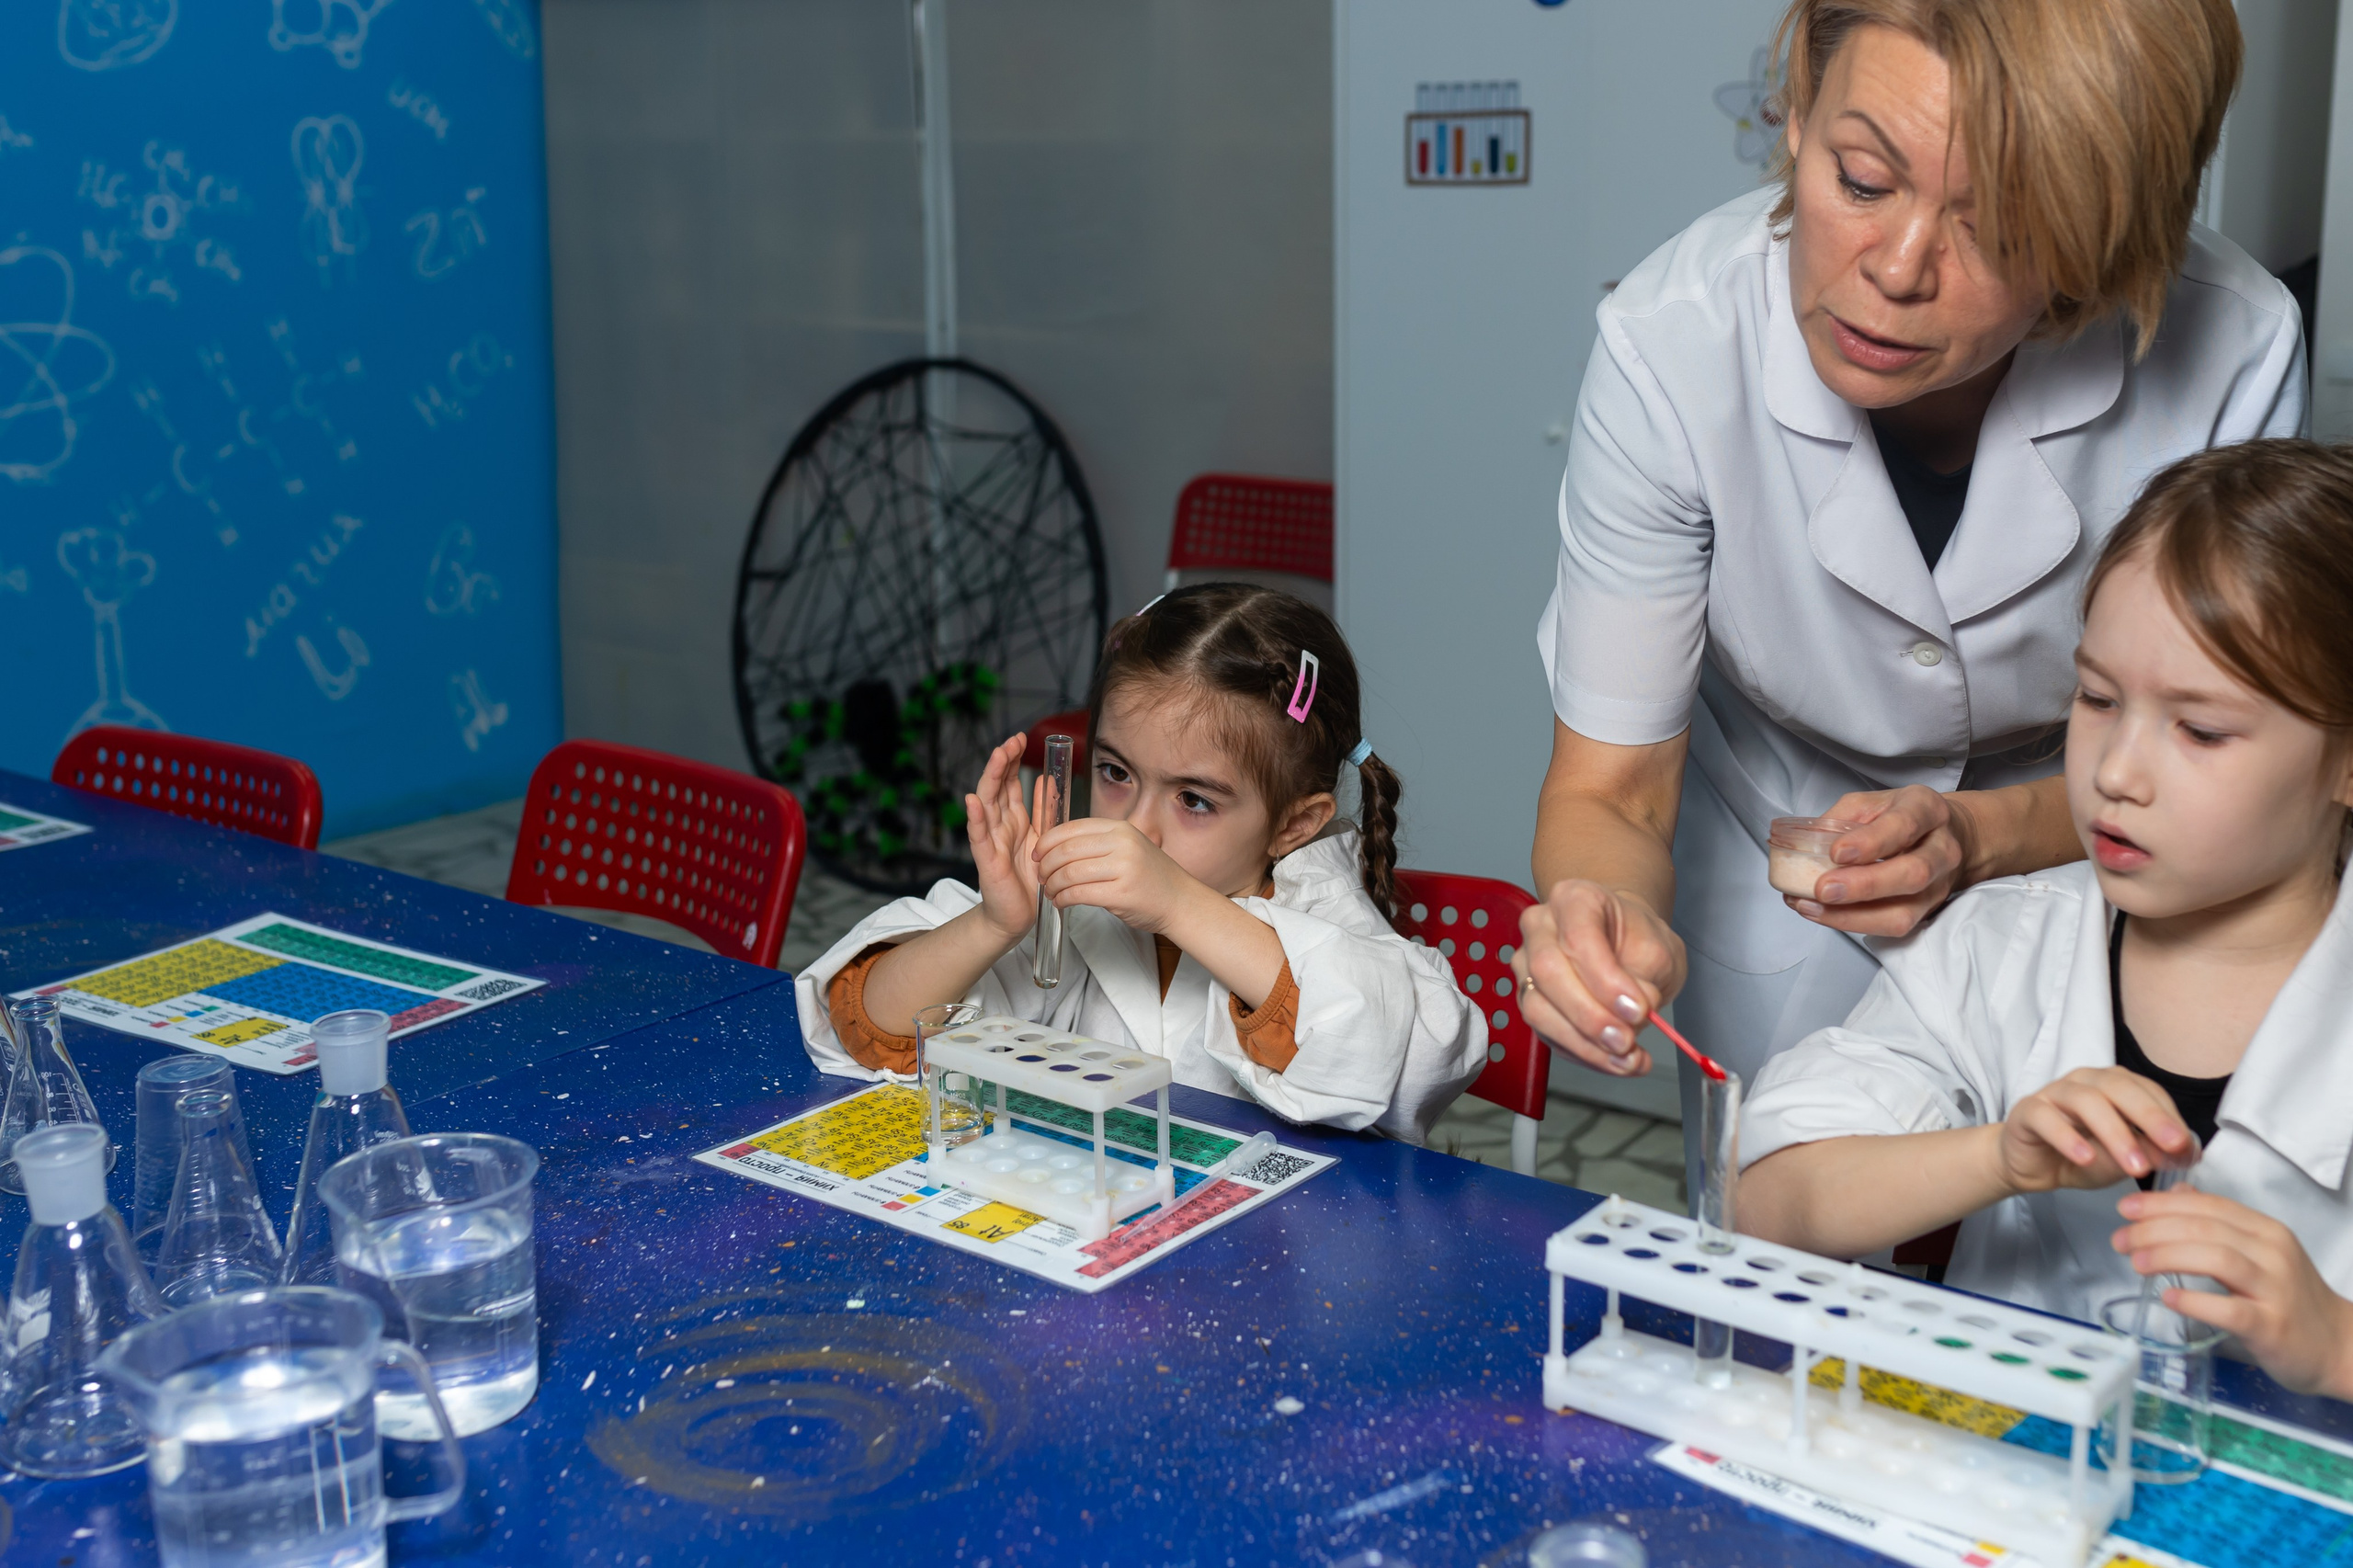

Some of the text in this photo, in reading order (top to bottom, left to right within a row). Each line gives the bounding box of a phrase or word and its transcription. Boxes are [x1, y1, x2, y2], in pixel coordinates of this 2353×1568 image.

[738, 1156, 787, 1175] просто
[949, 1220, 1015, 1239] At 85
